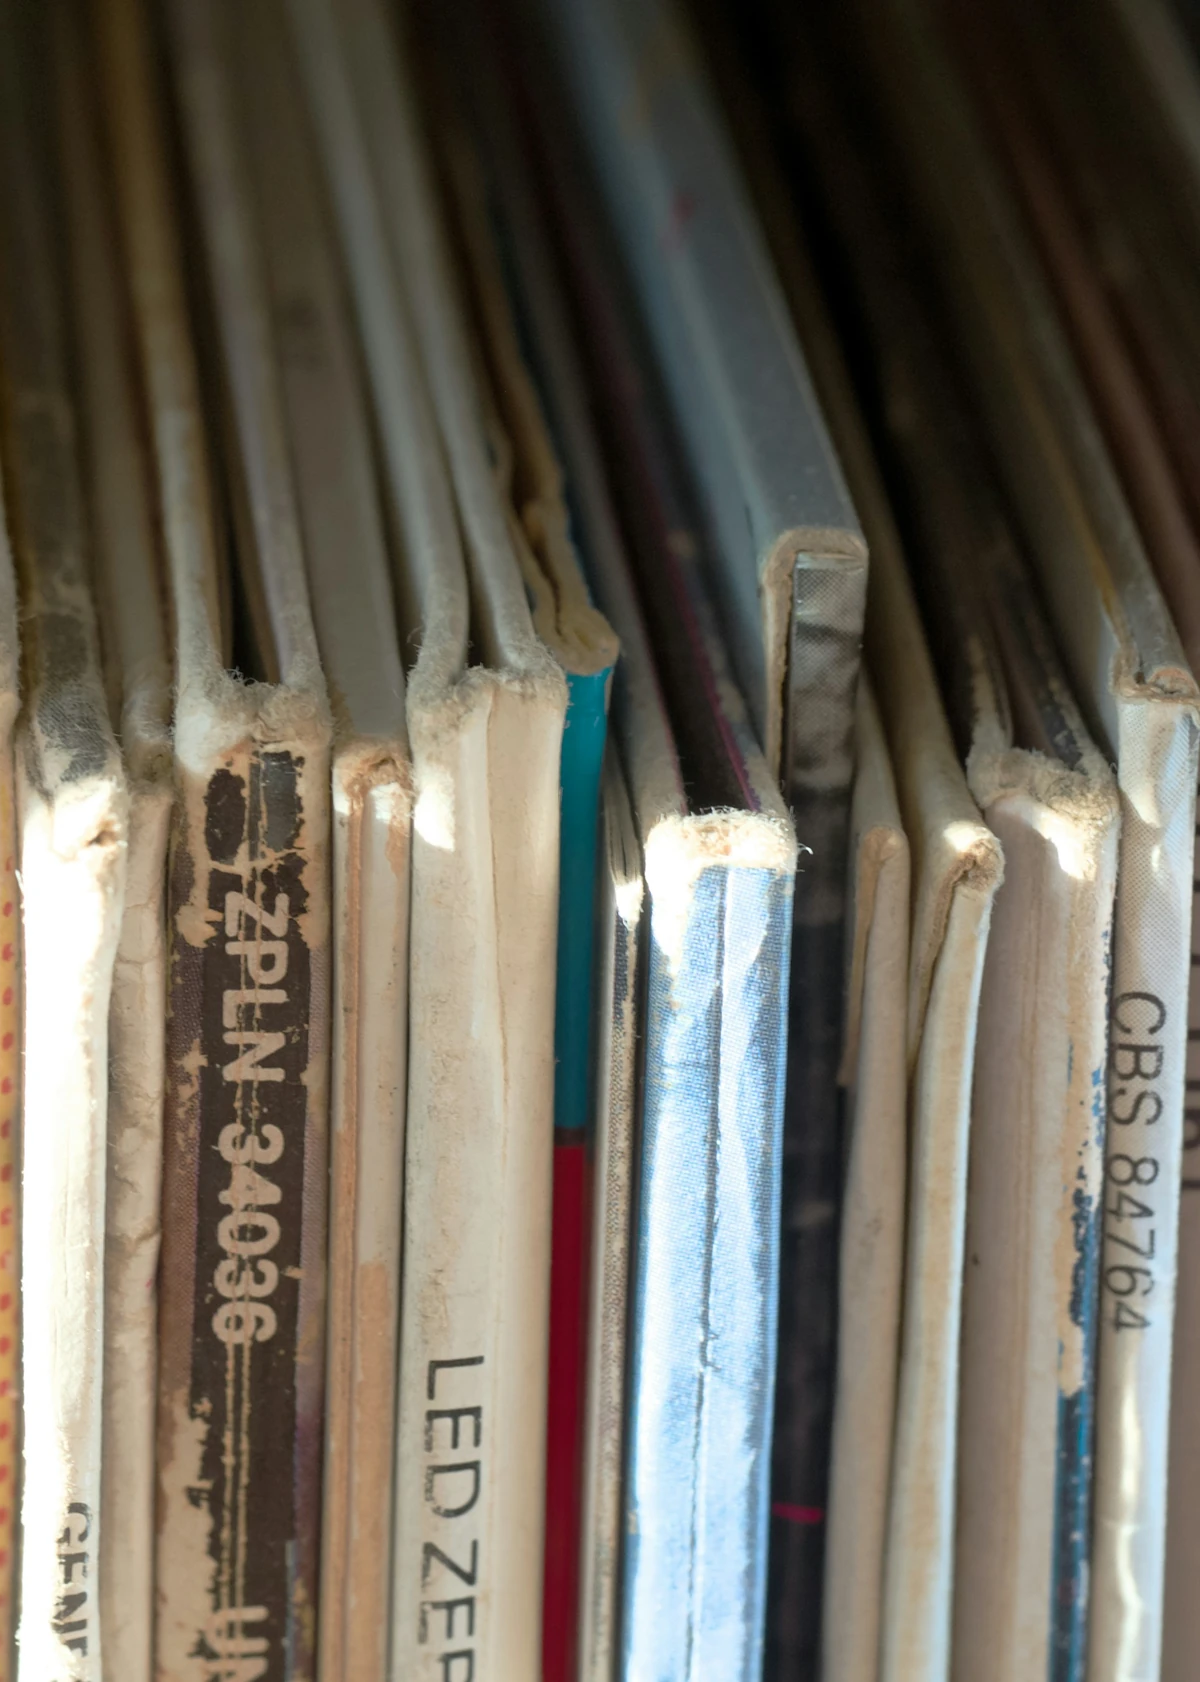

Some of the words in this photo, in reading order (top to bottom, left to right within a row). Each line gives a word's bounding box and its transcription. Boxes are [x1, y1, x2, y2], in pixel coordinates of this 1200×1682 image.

[223, 891, 290, 1084] ZPLN
[1108, 991, 1166, 1126] CBS
[212, 1123, 285, 1345] 34036
[1104, 1153, 1160, 1333] 84764
[424, 1355, 485, 1519] LED
